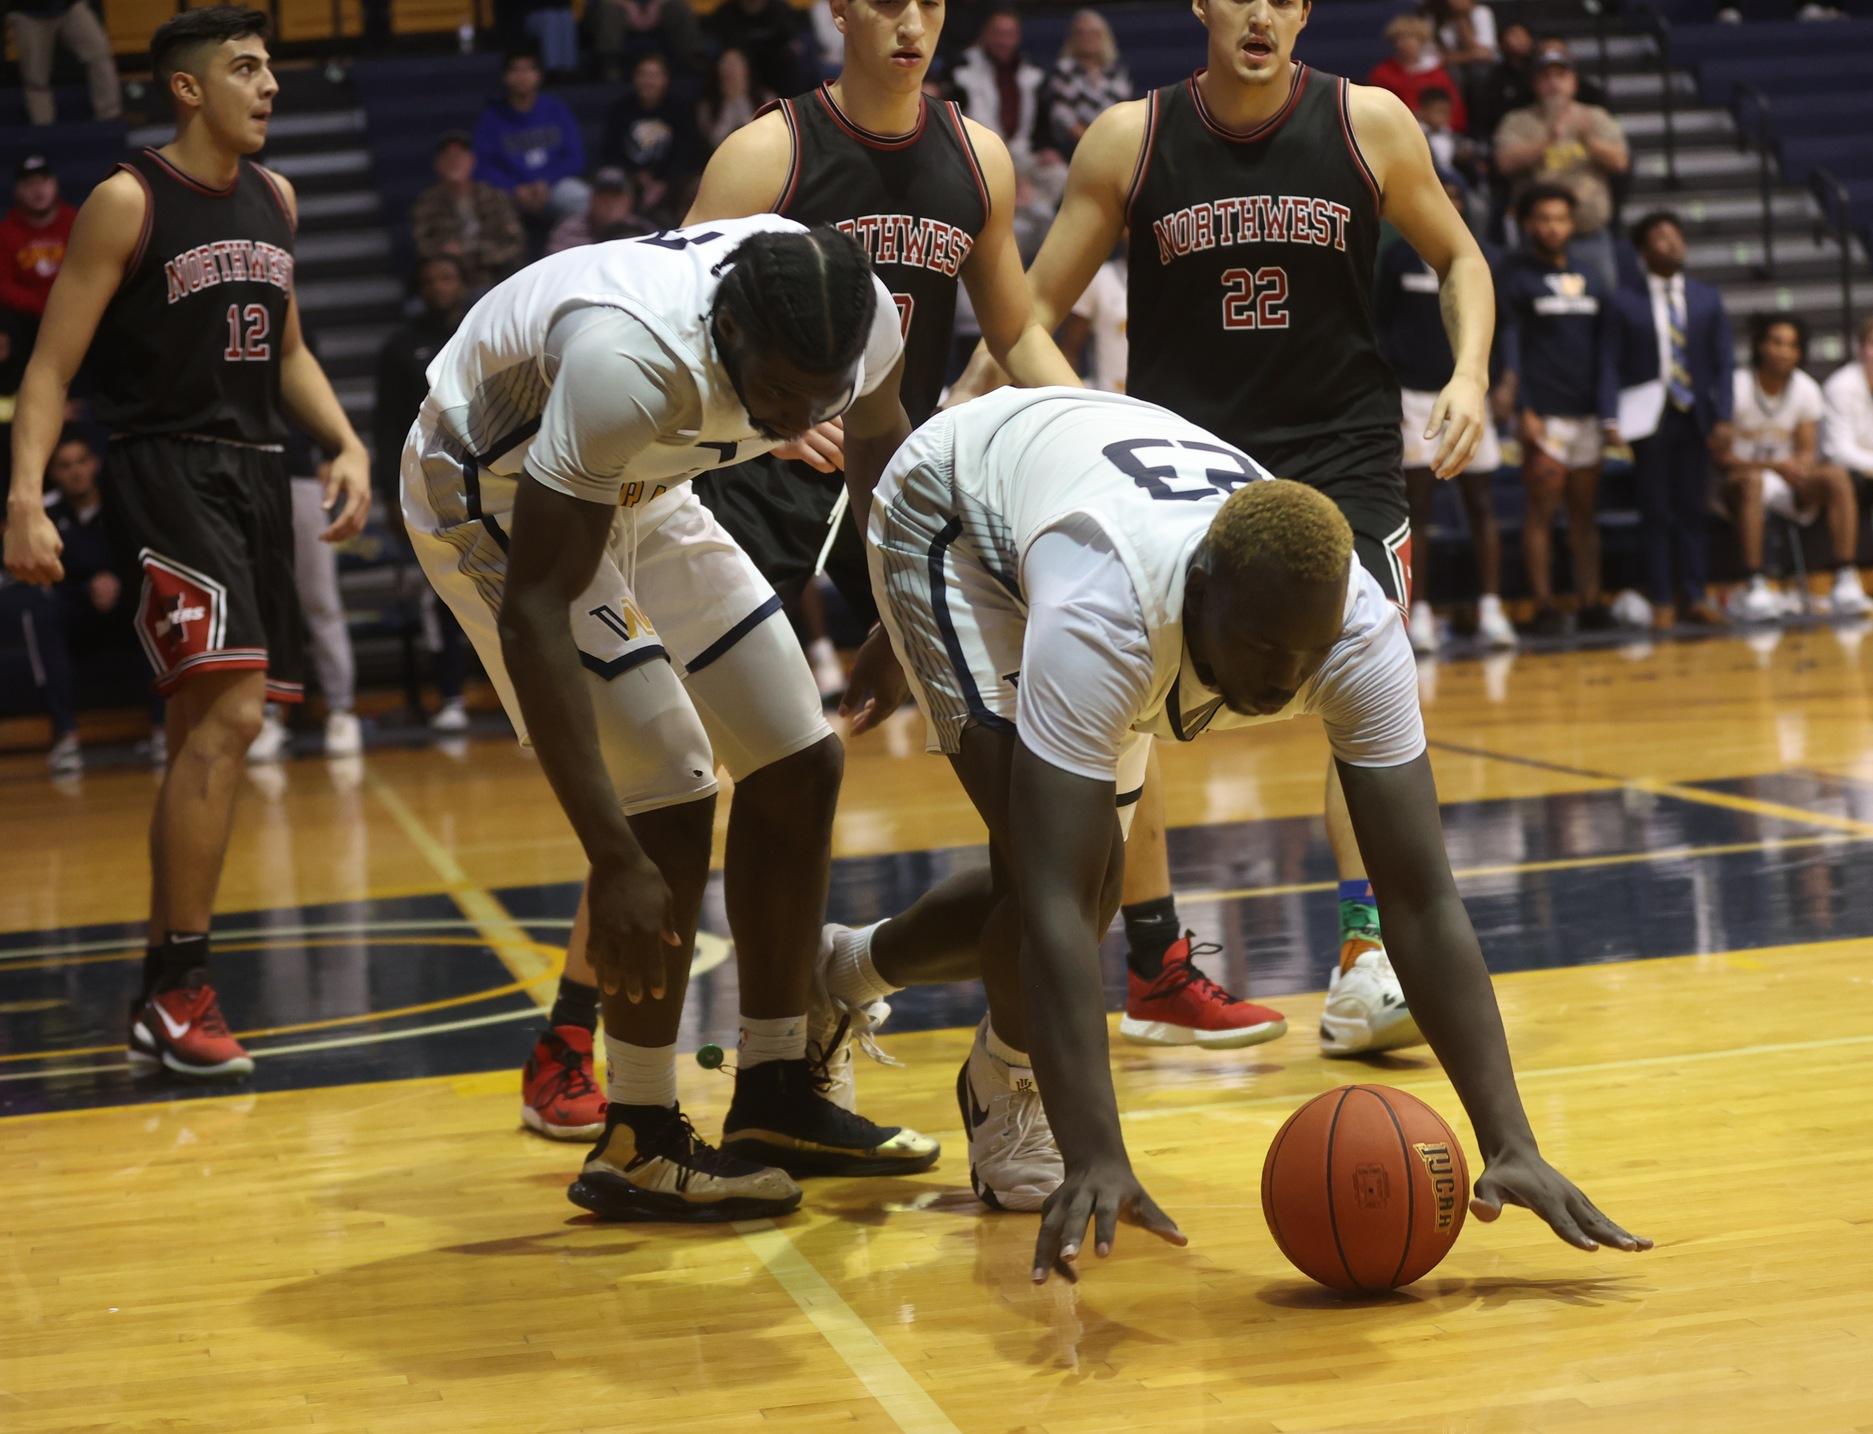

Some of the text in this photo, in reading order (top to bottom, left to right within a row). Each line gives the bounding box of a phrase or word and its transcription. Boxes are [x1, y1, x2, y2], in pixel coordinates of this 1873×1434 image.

[1153, 195, 1350, 265] NORTHWEST
[1221, 266, 1289, 330] 22
[224, 303, 271, 361] 12
